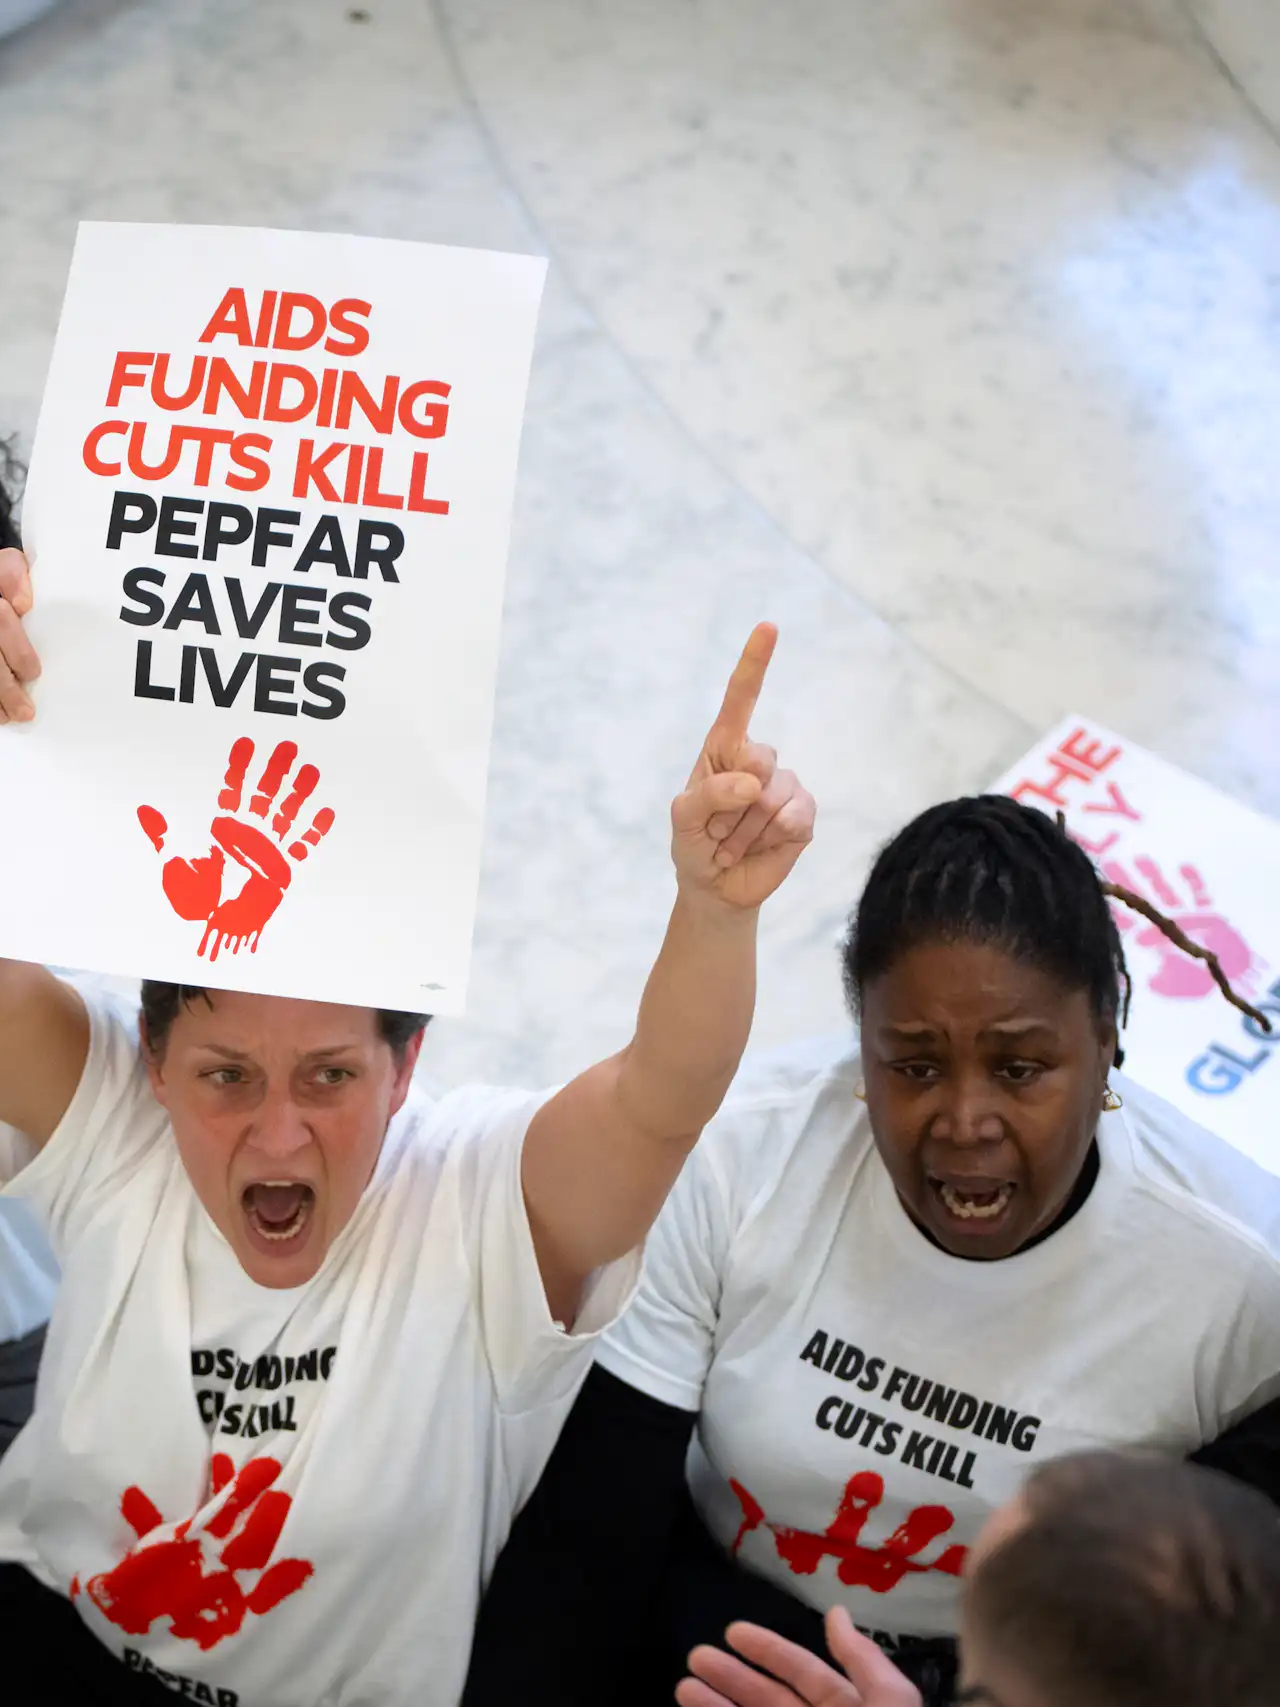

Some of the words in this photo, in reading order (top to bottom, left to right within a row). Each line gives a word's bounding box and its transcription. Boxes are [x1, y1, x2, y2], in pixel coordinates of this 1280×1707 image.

[198, 287, 372, 357] AIDS
[105, 351, 452, 439] FUNDING
[82, 420, 273, 492] CUTS
[292, 438, 450, 514] KILL
[105, 490, 405, 583] PEPFAR
[119, 566, 373, 651] SAVES
[134, 639, 347, 720] LIVES
[1187, 977, 1280, 1095] GLO
[799, 1328, 886, 1392] AIDS
[881, 1366, 1042, 1451] FUNDING
[815, 1395, 903, 1455] CUTS
[900, 1430, 977, 1489] KILL
